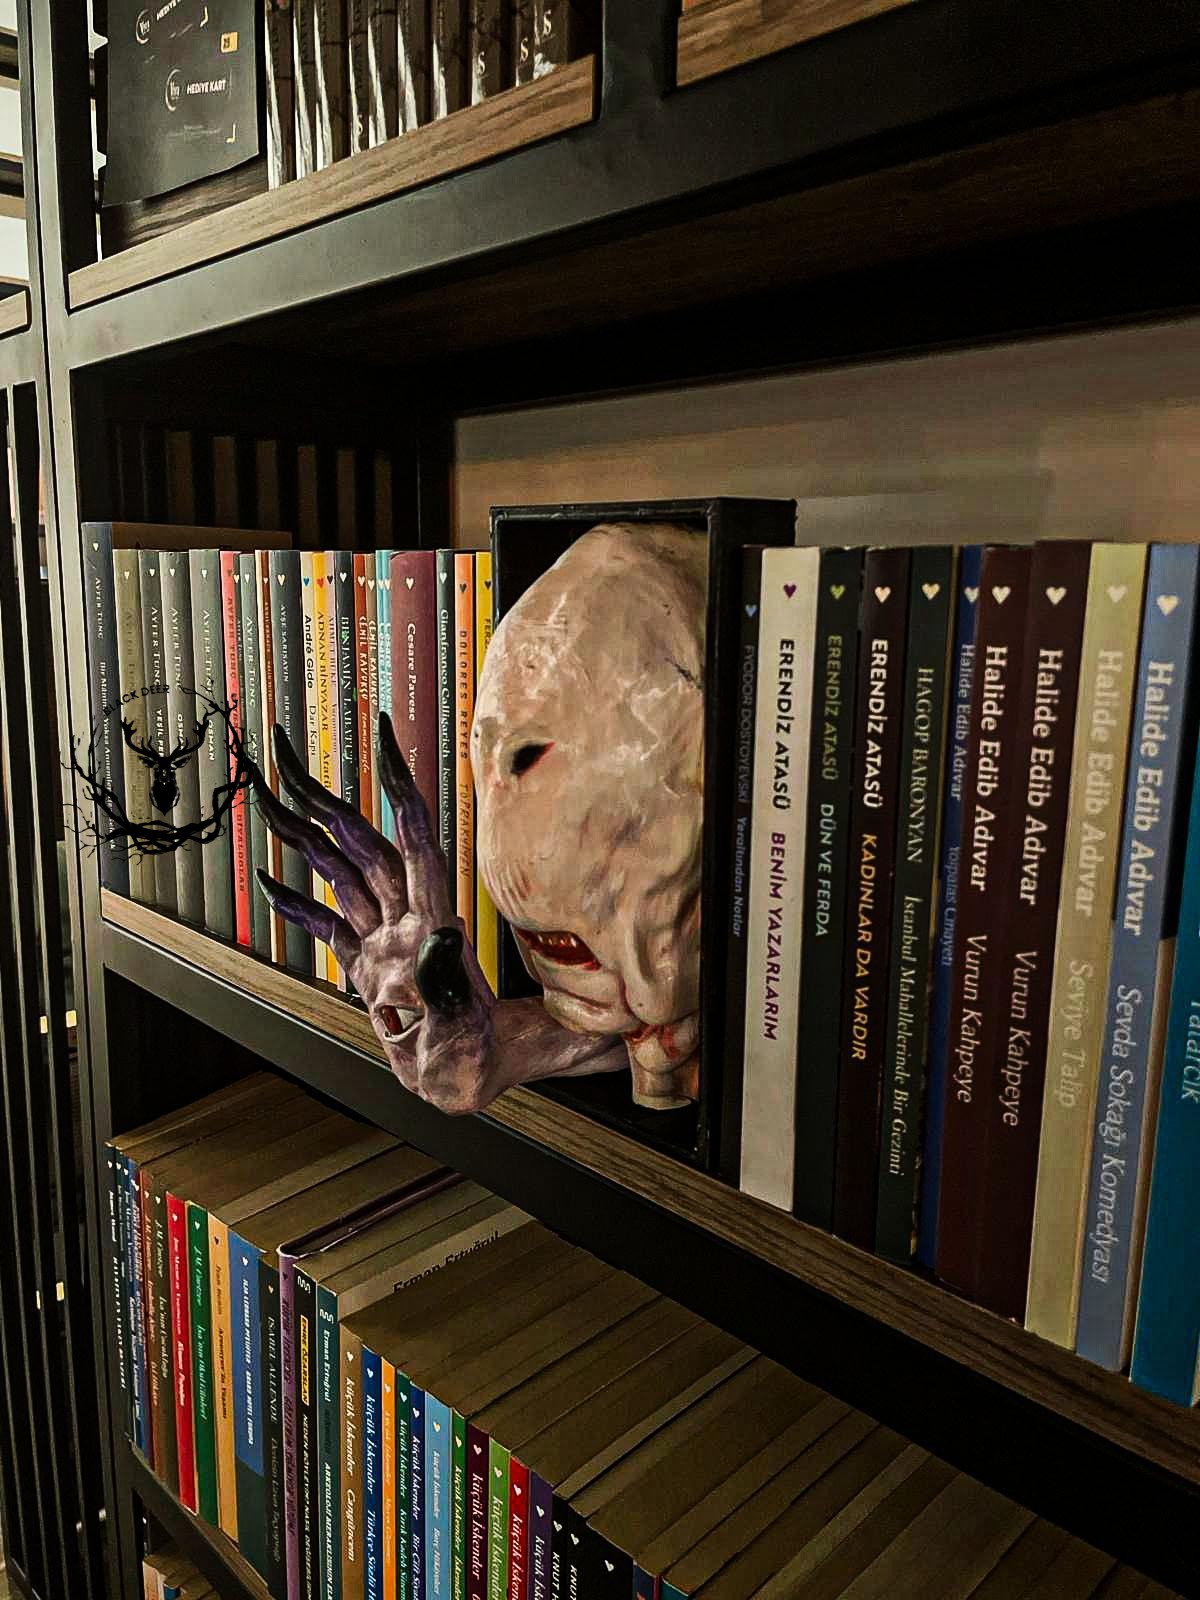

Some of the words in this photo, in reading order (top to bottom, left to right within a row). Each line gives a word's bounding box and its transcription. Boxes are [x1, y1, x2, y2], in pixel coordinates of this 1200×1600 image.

[304, 614, 314, 654] André
[317, 611, 327, 661] ADNAN
[407, 622, 416, 671] Cesare
[459, 629, 468, 700] DOLORES
[306, 657, 315, 689] Gide
[319, 664, 330, 732] BİNYAZAR
[407, 674, 417, 722] Pavese
[775, 638, 796, 735] ERENDİZ
[824, 634, 843, 718] ERENDİZ
[867, 638, 889, 735] ERENDİZ
[957, 643, 977, 698] Halide
[980, 645, 1008, 732] Halide
[1032, 648, 1064, 739] Halide
[1091, 649, 1124, 742] Halide
[460, 710, 468, 760] REYES
[913, 667, 935, 743] HAGOP
[954, 703, 972, 741] Edib
[1139, 659, 1175, 758] Halide
[772, 740, 792, 811] ATASÜ
[821, 721, 840, 781] ATASÜ
[862, 739, 884, 809] ATASÜ
[950, 745, 968, 802] Adıvar
[975, 738, 1002, 797] Edib
[1027, 746, 1056, 807] Edib
[1085, 751, 1115, 815] Edib
[819, 803, 835, 846] DÜN
[906, 748, 930, 864] BARONYAN
[1133, 767, 1165, 832] Edib
[768, 831, 787, 900] BENİM
[817, 849, 832, 874] VE
[970, 803, 996, 892] Adıvar
[1019, 814, 1049, 906] Adıvar
[1074, 820, 1107, 917] Adıvar
[815, 878, 831, 937] FERDA
[857, 832, 878, 942] KADINLAR
[1122, 839, 1155, 938] Adıvar
[763, 907, 784, 1041] YAZARLARIM
[855, 947, 872, 978] DA
[965, 934, 988, 1002] Vurun
[1010, 950, 1038, 1020] Vurun
[851, 985, 870, 1061] VARDIR
[1059, 959, 1094, 1042] Seviye
[1111, 984, 1143, 1059] Sevda
[953, 1007, 983, 1103] Kahpeye
[998, 1026, 1032, 1127] Kahpeye
[1052, 1048, 1086, 1109] Talip
[1098, 1063, 1135, 1149] Sokağı
[1089, 1152, 1127, 1285] Komedyası
[323, 1329, 331, 1364] Erman
[365, 1394, 377, 1437] küçük
[366, 1437, 378, 1495] İskender
[470, 1473, 484, 1519] küçük
[472, 1519, 486, 1580] İskender
[491, 1496, 504, 1542] küçük
[510, 1513, 524, 1560] küçük
[532, 1535, 545, 1578] küçük
[551, 1551, 561, 1591] KNUT
